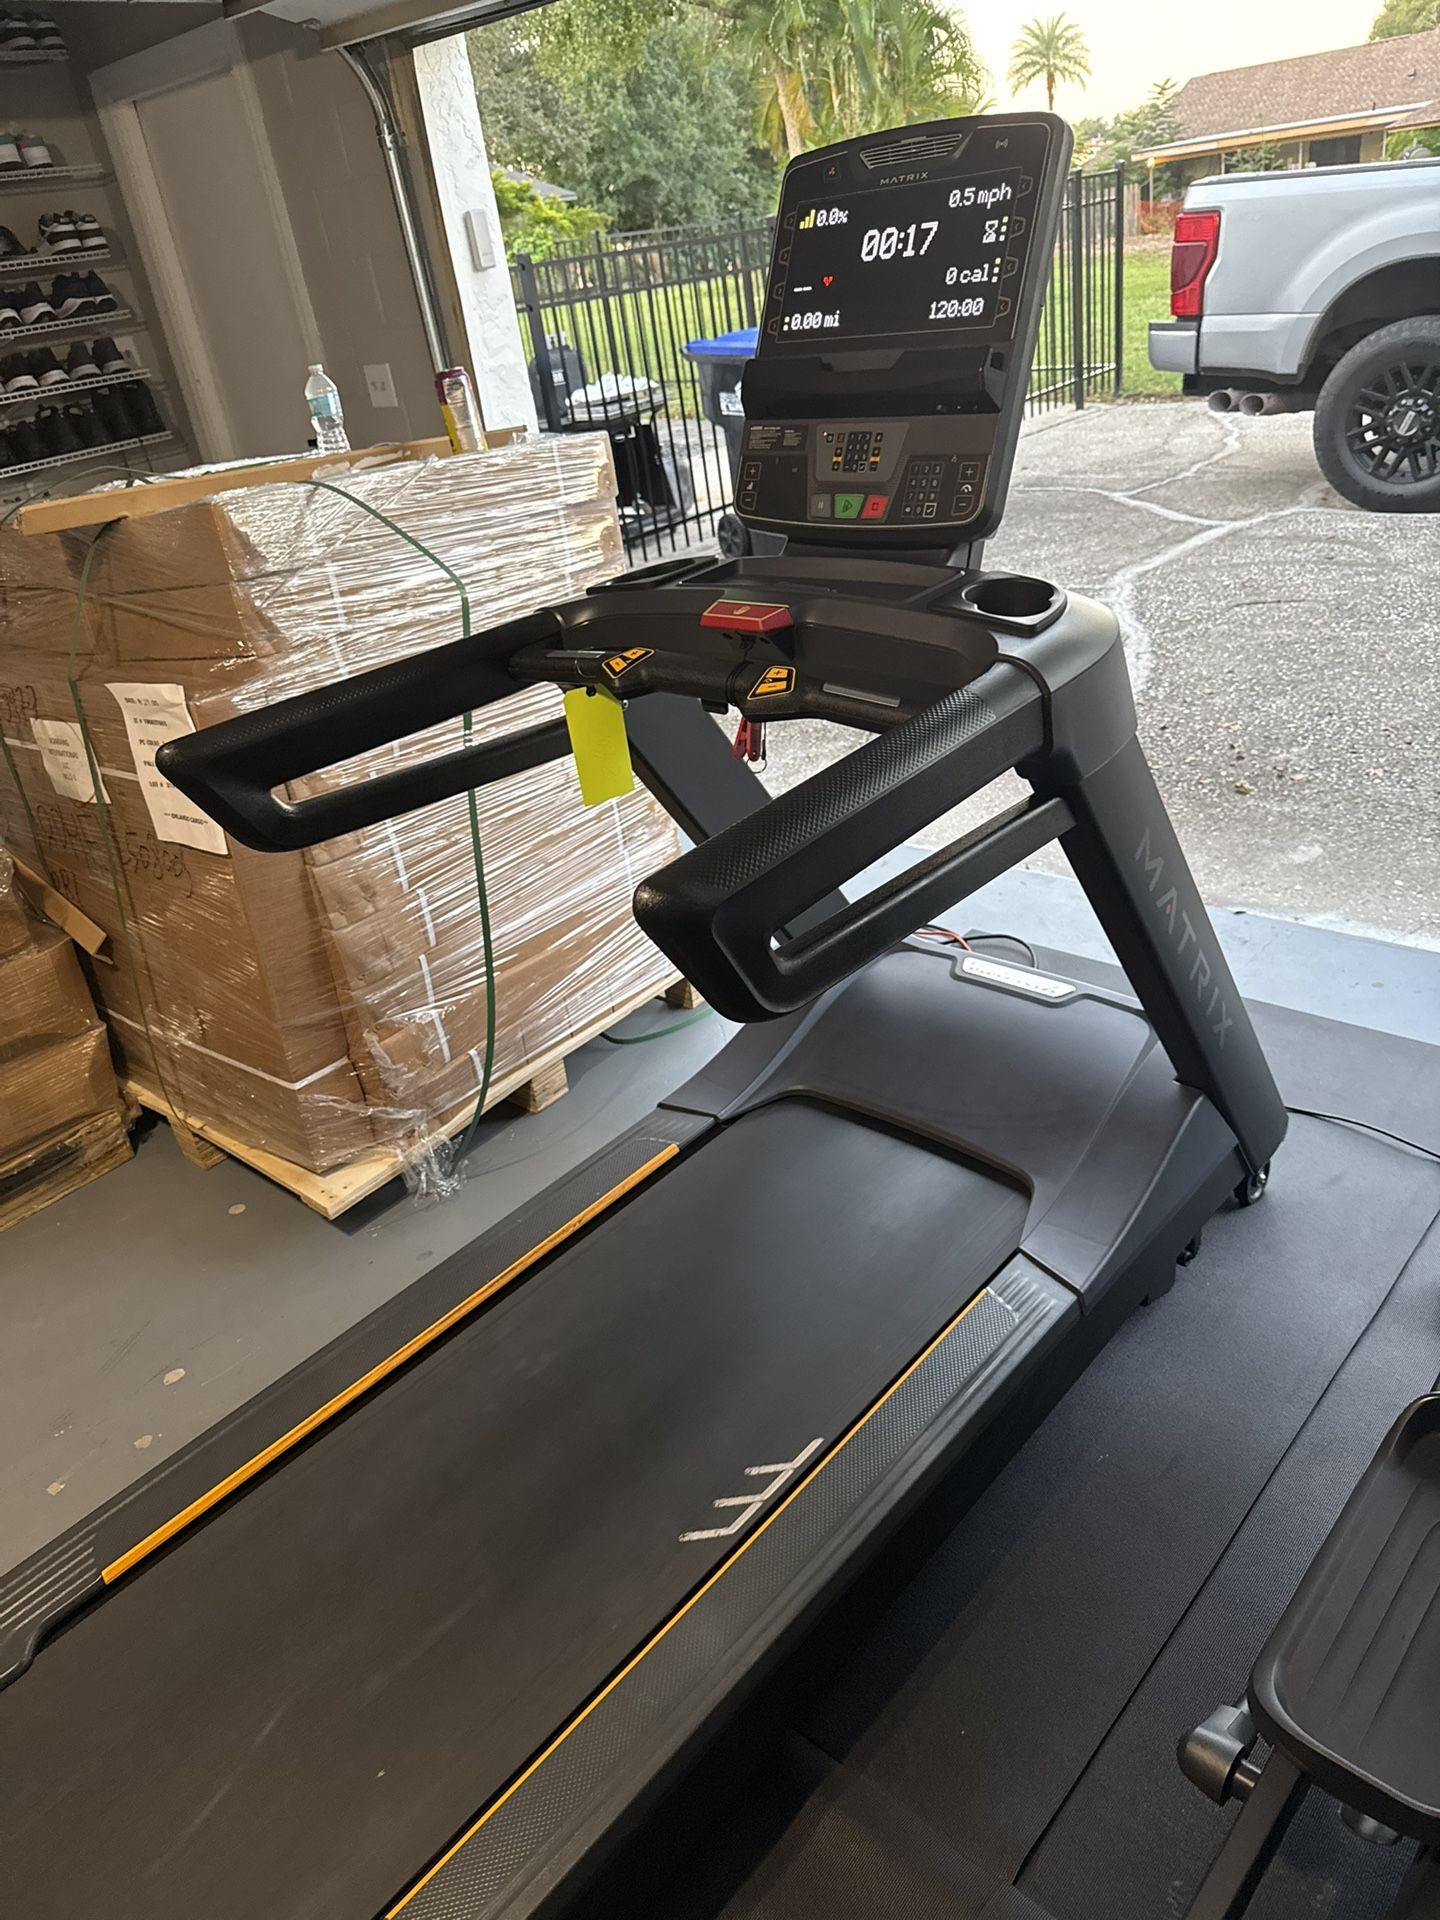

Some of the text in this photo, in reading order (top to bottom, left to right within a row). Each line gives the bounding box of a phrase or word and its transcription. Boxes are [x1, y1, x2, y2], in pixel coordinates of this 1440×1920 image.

[880, 171, 929, 186] MATRIX
[949, 182, 1012, 210] 0.5 mph
[815, 207, 849, 227] 0.0%
[860, 221, 939, 263] 00:17
[945, 264, 989, 286] 0 cal
[823, 309, 841, 328] mi
[928, 297, 986, 320] 120:00
[1134, 827, 1233, 1049] MATRIX
